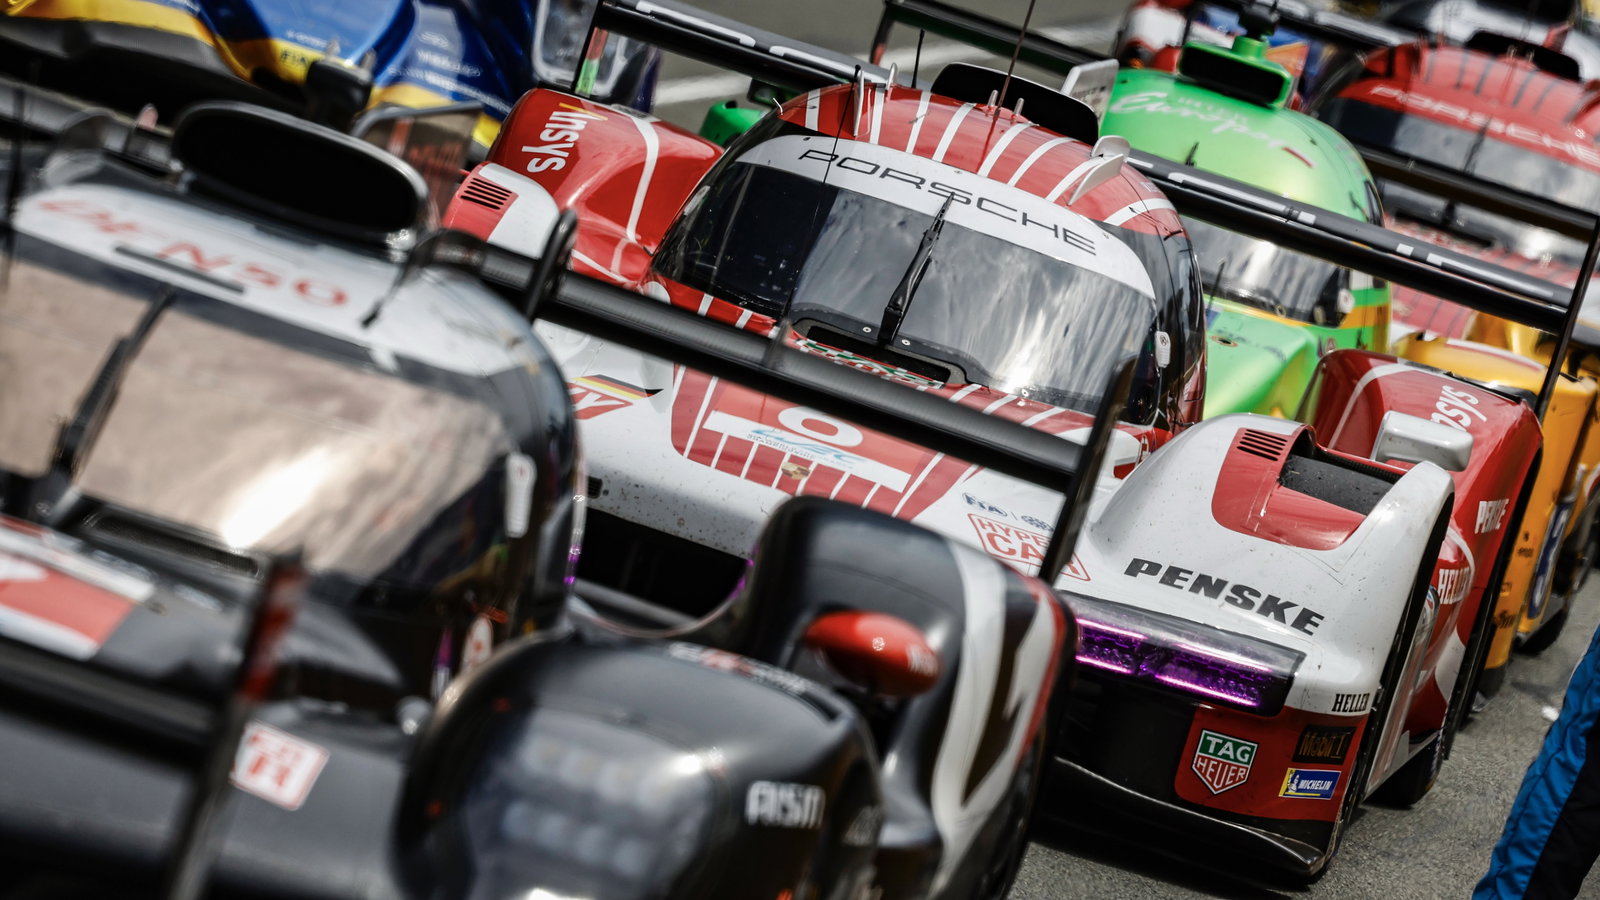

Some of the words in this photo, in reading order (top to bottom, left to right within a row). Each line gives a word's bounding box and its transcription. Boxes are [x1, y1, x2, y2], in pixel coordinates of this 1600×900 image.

[521, 102, 609, 173] Ansys
[1370, 84, 1600, 167] PORSCHE
[798, 149, 1097, 256] PORSCHE
[1429, 385, 1488, 432] nsys
[962, 492, 1008, 517] FIA
[977, 518, 1053, 550] HYPE
[1123, 557, 1325, 636] PENSKE
[1205, 736, 1252, 763] TAG
[1196, 757, 1249, 790] HEUER
[1297, 779, 1333, 791] MICHELIN
